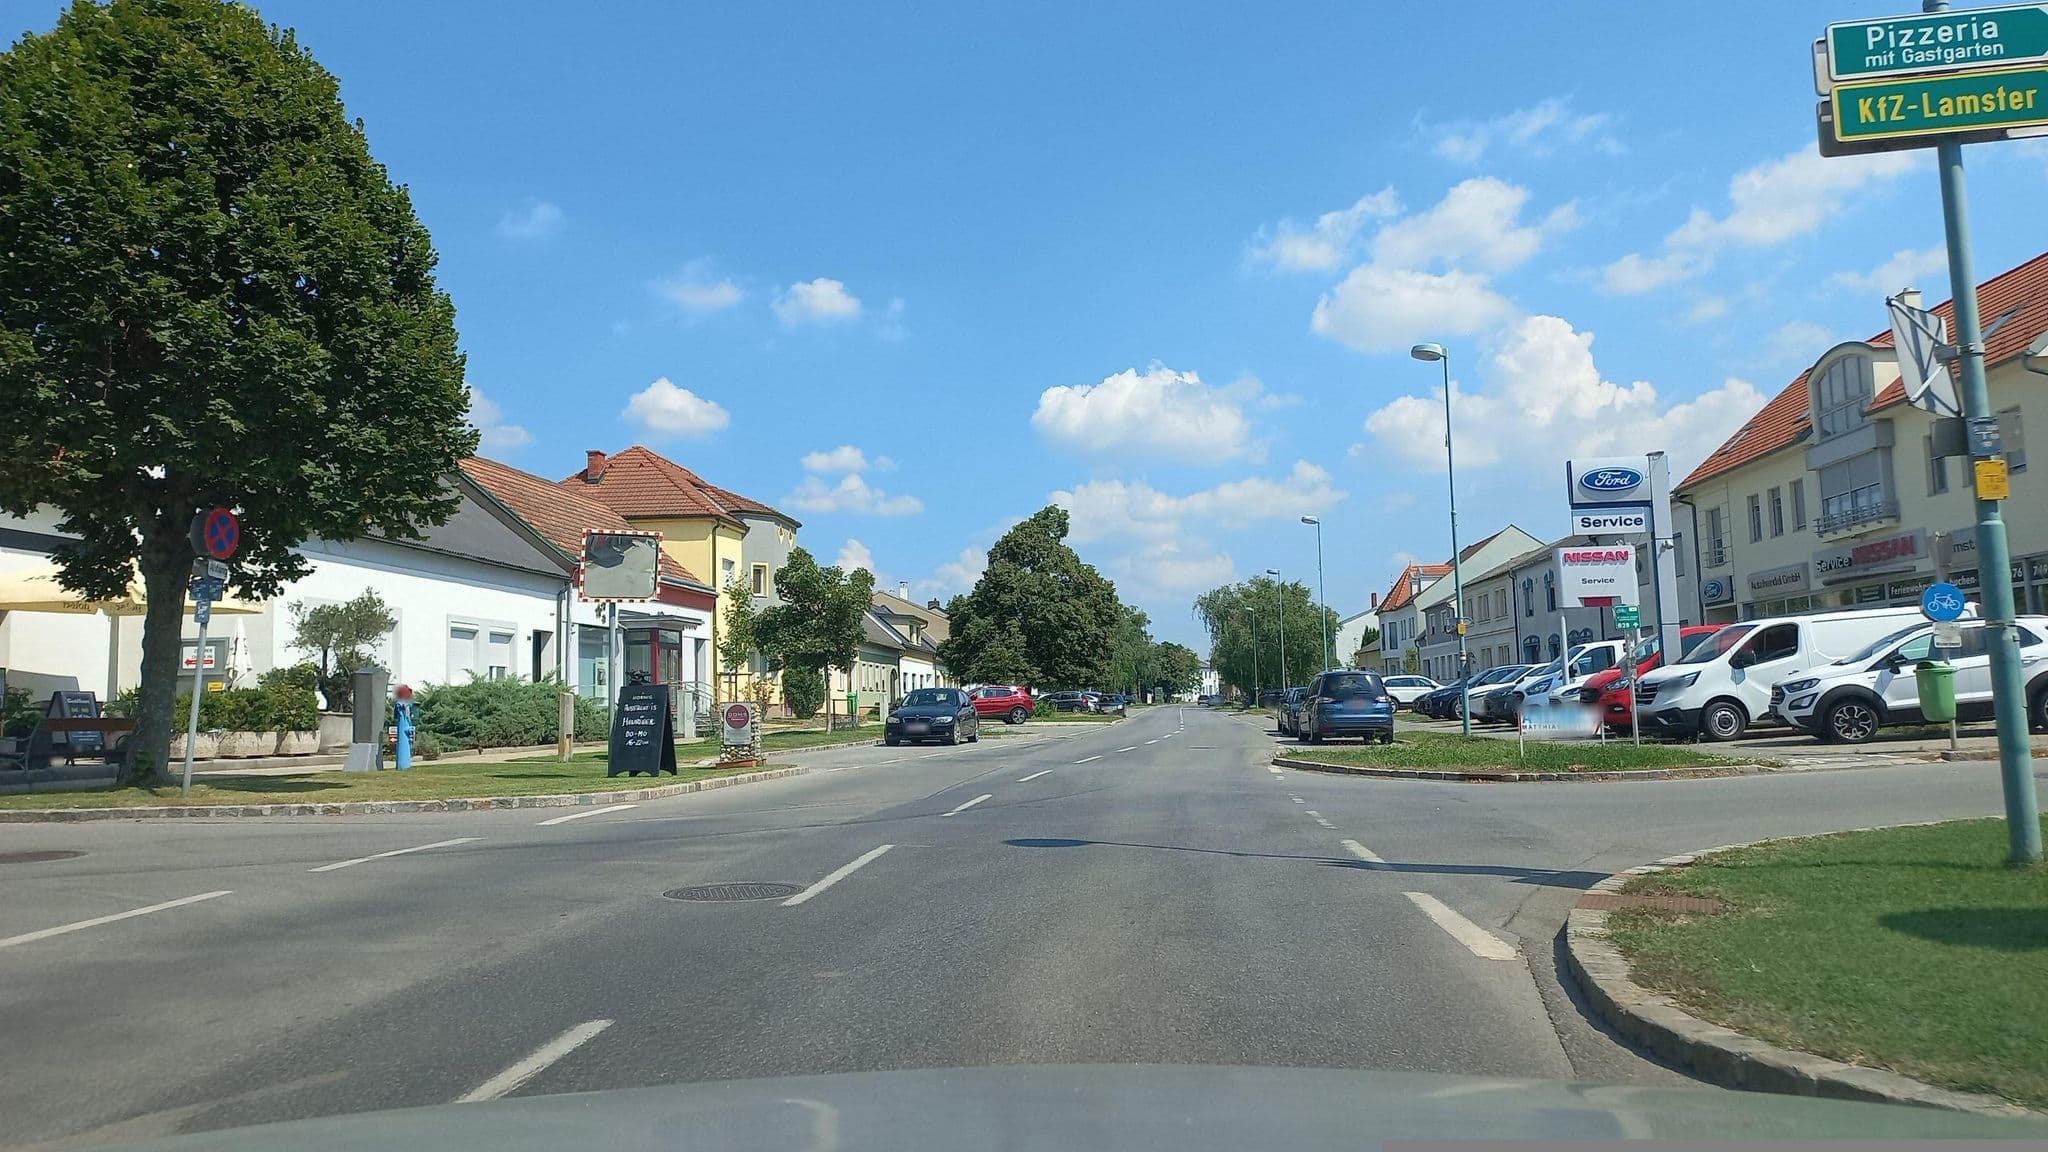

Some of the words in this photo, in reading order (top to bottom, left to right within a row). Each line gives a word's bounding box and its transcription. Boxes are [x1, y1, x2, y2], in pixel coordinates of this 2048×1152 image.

[1866, 17, 1999, 50] Pizzeria
[1865, 51, 1896, 68] mit
[1902, 42, 2005, 65] Gastgarten
[1858, 85, 2038, 124] KfZ-Lamster
[1594, 471, 1632, 487] Ford
[1580, 515, 1645, 529] Service
[1563, 550, 1629, 564] NISSAN
[1815, 555, 1853, 573] Service
[1851, 534, 1917, 566] NISSAN
[1581, 577, 1615, 585] Service
